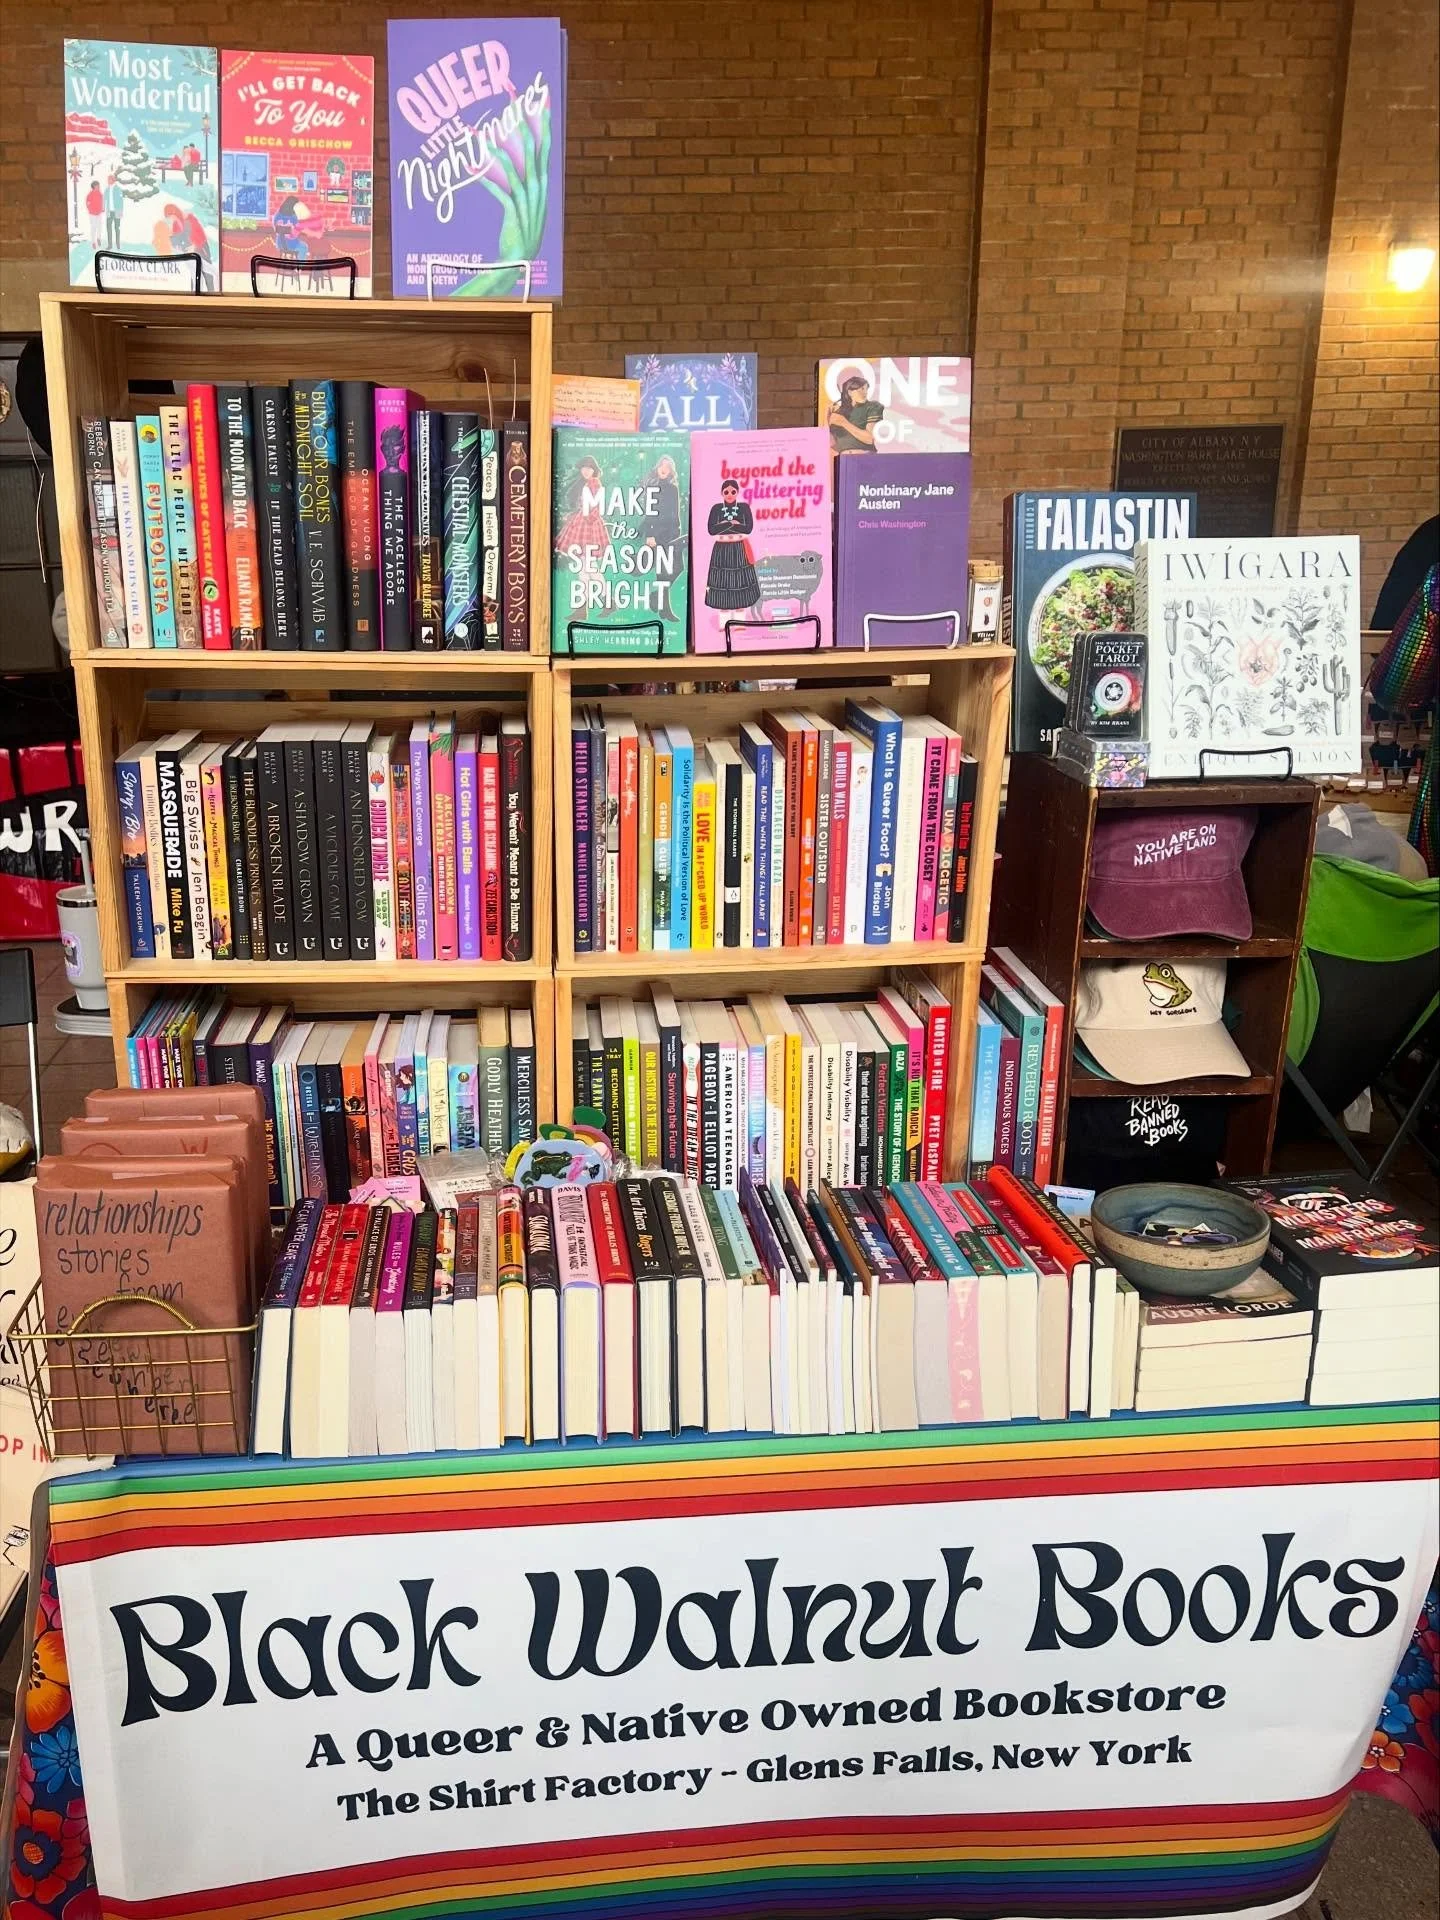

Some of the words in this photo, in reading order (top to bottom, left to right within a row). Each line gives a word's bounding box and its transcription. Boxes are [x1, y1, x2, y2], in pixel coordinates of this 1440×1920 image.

[108, 48, 172, 80] Most
[72, 77, 210, 113] Wonderful
[237, 80, 268, 102] I'LL
[272, 75, 306, 91] GET
[312, 77, 361, 108] BACK
[396, 40, 516, 134] QUEER
[254, 98, 284, 125] To
[288, 100, 345, 133] You
[244, 136, 283, 146] BECCA
[397, 71, 549, 224] Nightmares
[420, 115, 466, 160] LITTLE
[825, 357, 960, 407] ONE
[226, 397, 241, 411] TO
[265, 399, 276, 440] CARSON
[311, 391, 327, 428] BURY
[648, 395, 731, 426] ALL
[168, 414, 179, 436] THE
[228, 414, 242, 435] THE
[873, 419, 913, 444] OF
[229, 439, 245, 470] MOON
[294, 405, 313, 477] MIDNIGHT
[314, 435, 328, 469] OUR
[1122, 450, 1182, 463] WASHINGTON
[1187, 449, 1213, 462] PARK
[1217, 448, 1243, 460] LAKE
[1248, 446, 1280, 459] HOUSE
[1142, 437, 1167, 449] CITY
[1172, 436, 1185, 448] OF
[1191, 435, 1235, 448] ALBANY
[1241, 435, 1249, 446] N
[1254, 435, 1261, 446] Y
[171, 444, 183, 481] LILAC
[267, 445, 278, 476] FAUST
[485, 456, 495, 493] Peaces
[720, 456, 784, 488] beyond
[788, 455, 815, 476] the
[231, 474, 246, 495] AND
[315, 475, 330, 523] BONES
[743, 479, 824, 507] glittering
[859, 484, 921, 500] Nonbinary
[924, 485, 954, 496] Jane
[173, 488, 186, 534] PEOPLE
[233, 499, 248, 528] BACK
[270, 500, 280, 510] IF
[298, 482, 314, 522] SOIL
[384, 489, 393, 529] THING
[395, 496, 403, 521] THE
[451, 476, 470, 537] CELESTIAL
[508, 465, 528, 568] CEMETERY
[582, 486, 660, 516] MAKE
[755, 498, 807, 520] world
[858, 498, 901, 510] Austen
[271, 515, 282, 534] THE
[485, 512, 495, 540] Helen
[604, 521, 638, 539] the
[858, 519, 878, 530] Chris
[879, 519, 926, 531] Washington
[1037, 499, 1190, 551] FALASTIN
[146, 482, 169, 615] FUTBOLISTA
[273, 539, 283, 565] DEAD
[385, 538, 393, 554] WE
[396, 529, 405, 593] FACELESS
[567, 544, 674, 575] SEASON
[177, 548, 188, 578] MILO
[236, 557, 251, 595] ELIANA
[452, 541, 469, 607] MONSTERS
[486, 552, 497, 594] Oyeyemi
[1164, 545, 1353, 581] IWÍGARA
[274, 570, 285, 608] BELONG
[309, 558, 325, 623] SCHWAB
[385, 562, 395, 605] ADORE
[508, 572, 526, 623] BOYS
[570, 580, 671, 611] BRIGHT
[181, 585, 192, 615] TODD
[238, 598, 254, 641] RAMAGE
[277, 612, 287, 637] HERE
[1095, 645, 1143, 654] POCKET
[1098, 654, 1138, 663] TAROT
[884, 732, 896, 764] What
[460, 767, 470, 787] Hot
[884, 768, 894, 778] Is
[184, 780, 198, 802] Big
[460, 792, 472, 817] Girls
[880, 782, 893, 819] Queer
[159, 761, 182, 878] MASQUERADE
[187, 807, 201, 850] Swiss
[370, 800, 387, 839] CHUCK
[461, 820, 473, 844] with
[879, 822, 892, 858] Food?
[1133, 843, 1182, 867] NATIVE
[1186, 835, 1217, 851] LAND
[1136, 838, 1165, 855] YOU
[1169, 828, 1196, 846] ARE
[1200, 824, 1217, 836] ON
[372, 842, 389, 881] TINGLE
[462, 847, 474, 875] Balls
[191, 871, 204, 892] Jen
[415, 876, 428, 916] Collins
[883, 885, 891, 908] John
[170, 888, 182, 918] Mike
[872, 881, 883, 916] Birdsall
[174, 920, 183, 934] Fu
[194, 897, 207, 940] Beagin
[418, 919, 428, 940] Fox
[1150, 1009, 1162, 1017] HEY
[1166, 1006, 1197, 1017] GORGEOUS
[486, 1057, 503, 1094] GODLY
[704, 1052, 718, 1102] PAGEBOY
[1001, 1060, 1015, 1118] INDIGENOUS
[1022, 1044, 1040, 1107] REVERED
[666, 1072, 677, 1113] Surviving
[724, 1066, 733, 1125] AMERICAN
[1127, 1094, 1170, 1117] READ
[669, 1115, 677, 1129] the
[1019, 1111, 1034, 1156] ROOTS
[1125, 1103, 1180, 1137] BANNED
[1144, 1119, 1189, 1147] BOOKS
[669, 1130, 678, 1158] Future
[704, 1122, 718, 1159] ELLIOT
[1001, 1121, 1012, 1155] VOICES
[725, 1130, 733, 1185] TEENAGER
[627, 1183, 642, 1195] The
[634, 1197, 645, 1206] Art
[1301, 1199, 1327, 1211] OF
[42, 1189, 206, 1253] relationships
[632, 1207, 648, 1230] Thieves
[1274, 1198, 1386, 1229] MONSTERS
[1297, 1219, 1417, 1250] MAINFRAMES
[57, 1240, 151, 1275] stories
[115, 1272, 184, 1300] from
[1150, 1306, 1221, 1320] AUDRE
[1224, 1300, 1293, 1315] LORDE
[109, 1577, 482, 1727] Black
[524, 1546, 983, 1681] Walnut
[1023, 1532, 1406, 1653] Books
[305, 1733, 341, 1768] A
[356, 1722, 523, 1772] Queer
[535, 1716, 571, 1749] &
[582, 1701, 749, 1746] Native
[760, 1687, 942, 1732] Owned
[953, 1680, 1227, 1721] Bookstore
[337, 1782, 420, 1822] The
[429, 1776, 537, 1811] Shirt
[544, 1764, 713, 1803] Factory
[746, 1751, 864, 1783] Glens
[873, 1742, 984, 1776] Falls,
[991, 1740, 1080, 1771] New
[1092, 1734, 1192, 1767] York
